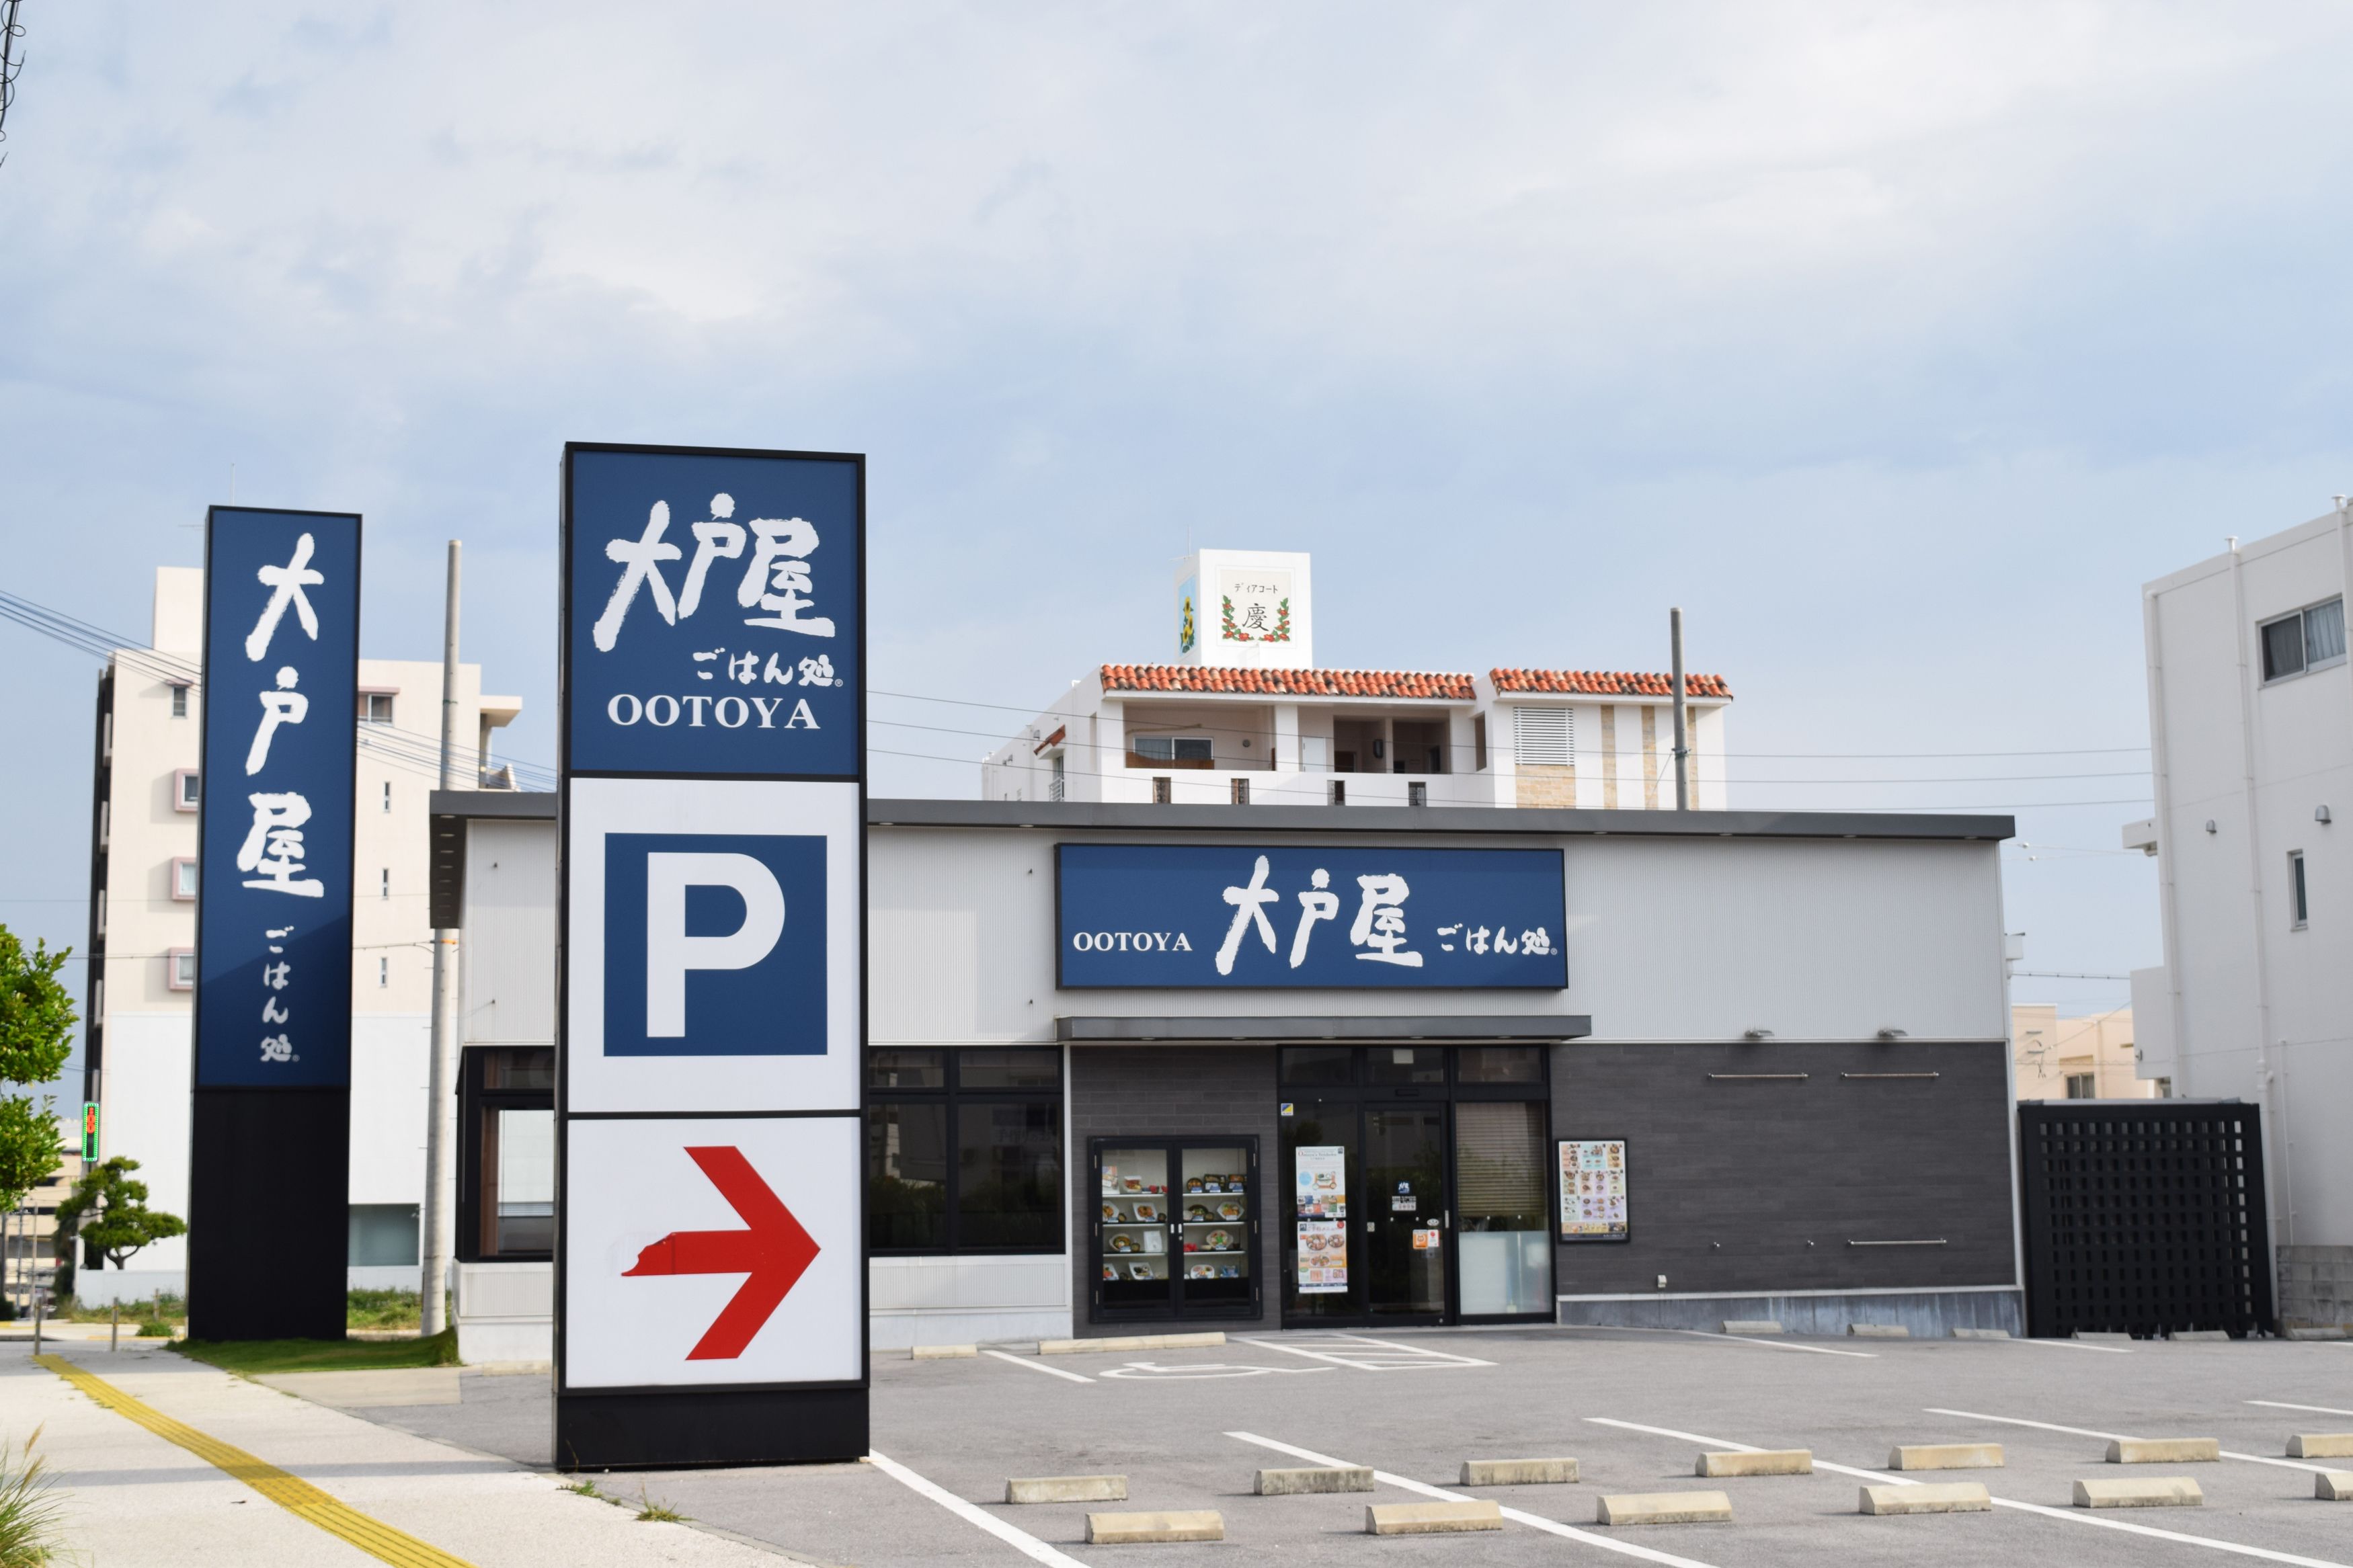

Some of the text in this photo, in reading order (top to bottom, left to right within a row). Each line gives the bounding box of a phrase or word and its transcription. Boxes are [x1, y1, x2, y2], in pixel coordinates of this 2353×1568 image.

[593, 493, 835, 652] 大戸屋
[1234, 583, 1278, 594] ディアコート
[1242, 603, 1269, 632] 慶
[237, 533, 324, 897] 大戸屋
[607, 694, 821, 729] OOTOYA
[647, 852, 785, 1038] P
[1073, 932, 1193, 952] OOTOYA
[1215, 855, 1423, 976] 大戸屋
